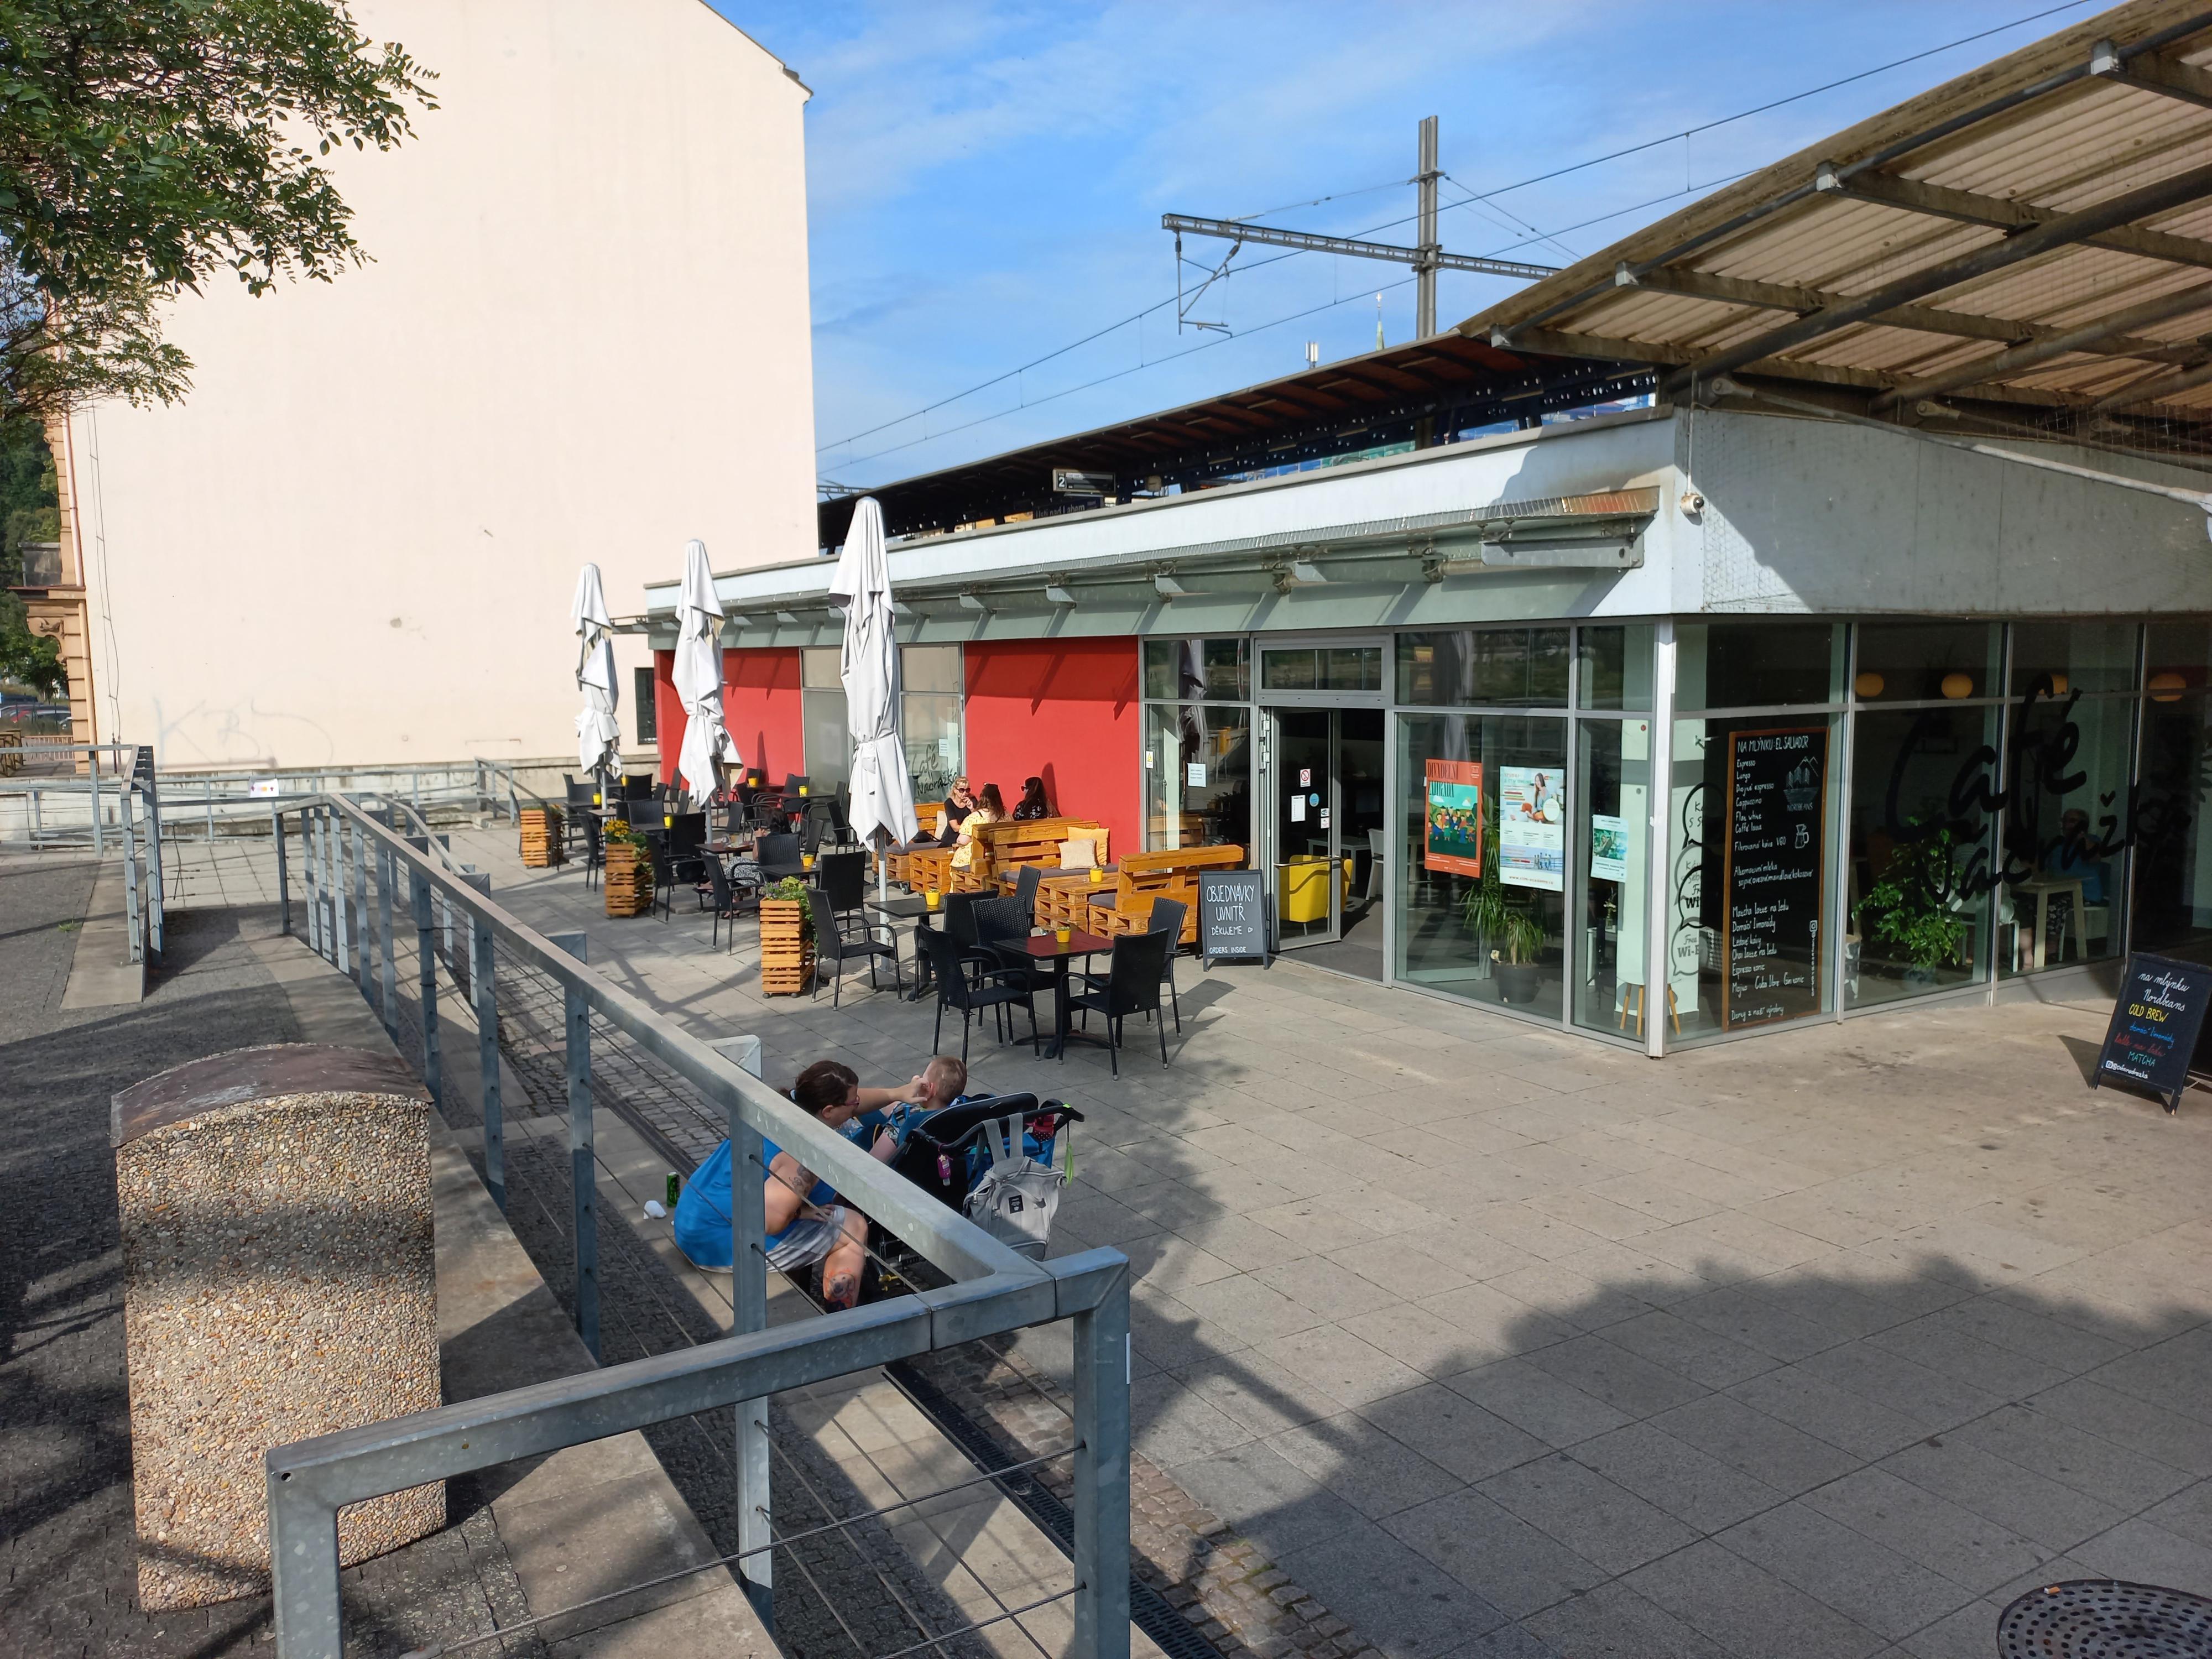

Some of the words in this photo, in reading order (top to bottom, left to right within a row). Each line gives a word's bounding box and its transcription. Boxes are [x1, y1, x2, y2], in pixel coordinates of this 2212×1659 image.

[1058, 477, 1065, 487] 2
[1738, 741, 1747, 753] NA
[1776, 737, 1782, 750] EL
[1783, 735, 1809, 749] SALVADOR
[1736, 759, 1756, 770] Espresso
[1736, 771, 1751, 783] Lungo
[1206, 883, 1254, 902] OBJEDNÁVKY
[1215, 902, 1245, 921] UVNITŘ
[1211, 925, 1243, 936] DĚKUJEME
[2138, 973, 2154, 982] na
[2153, 972, 2190, 995] mlýnku
[2143, 988, 2185, 1011] Nordbeans
[2128, 1004, 2145, 1017] COLD
[2146, 1008, 2169, 1022] BREW
[2127, 1051, 2156, 1067] MATCHA
